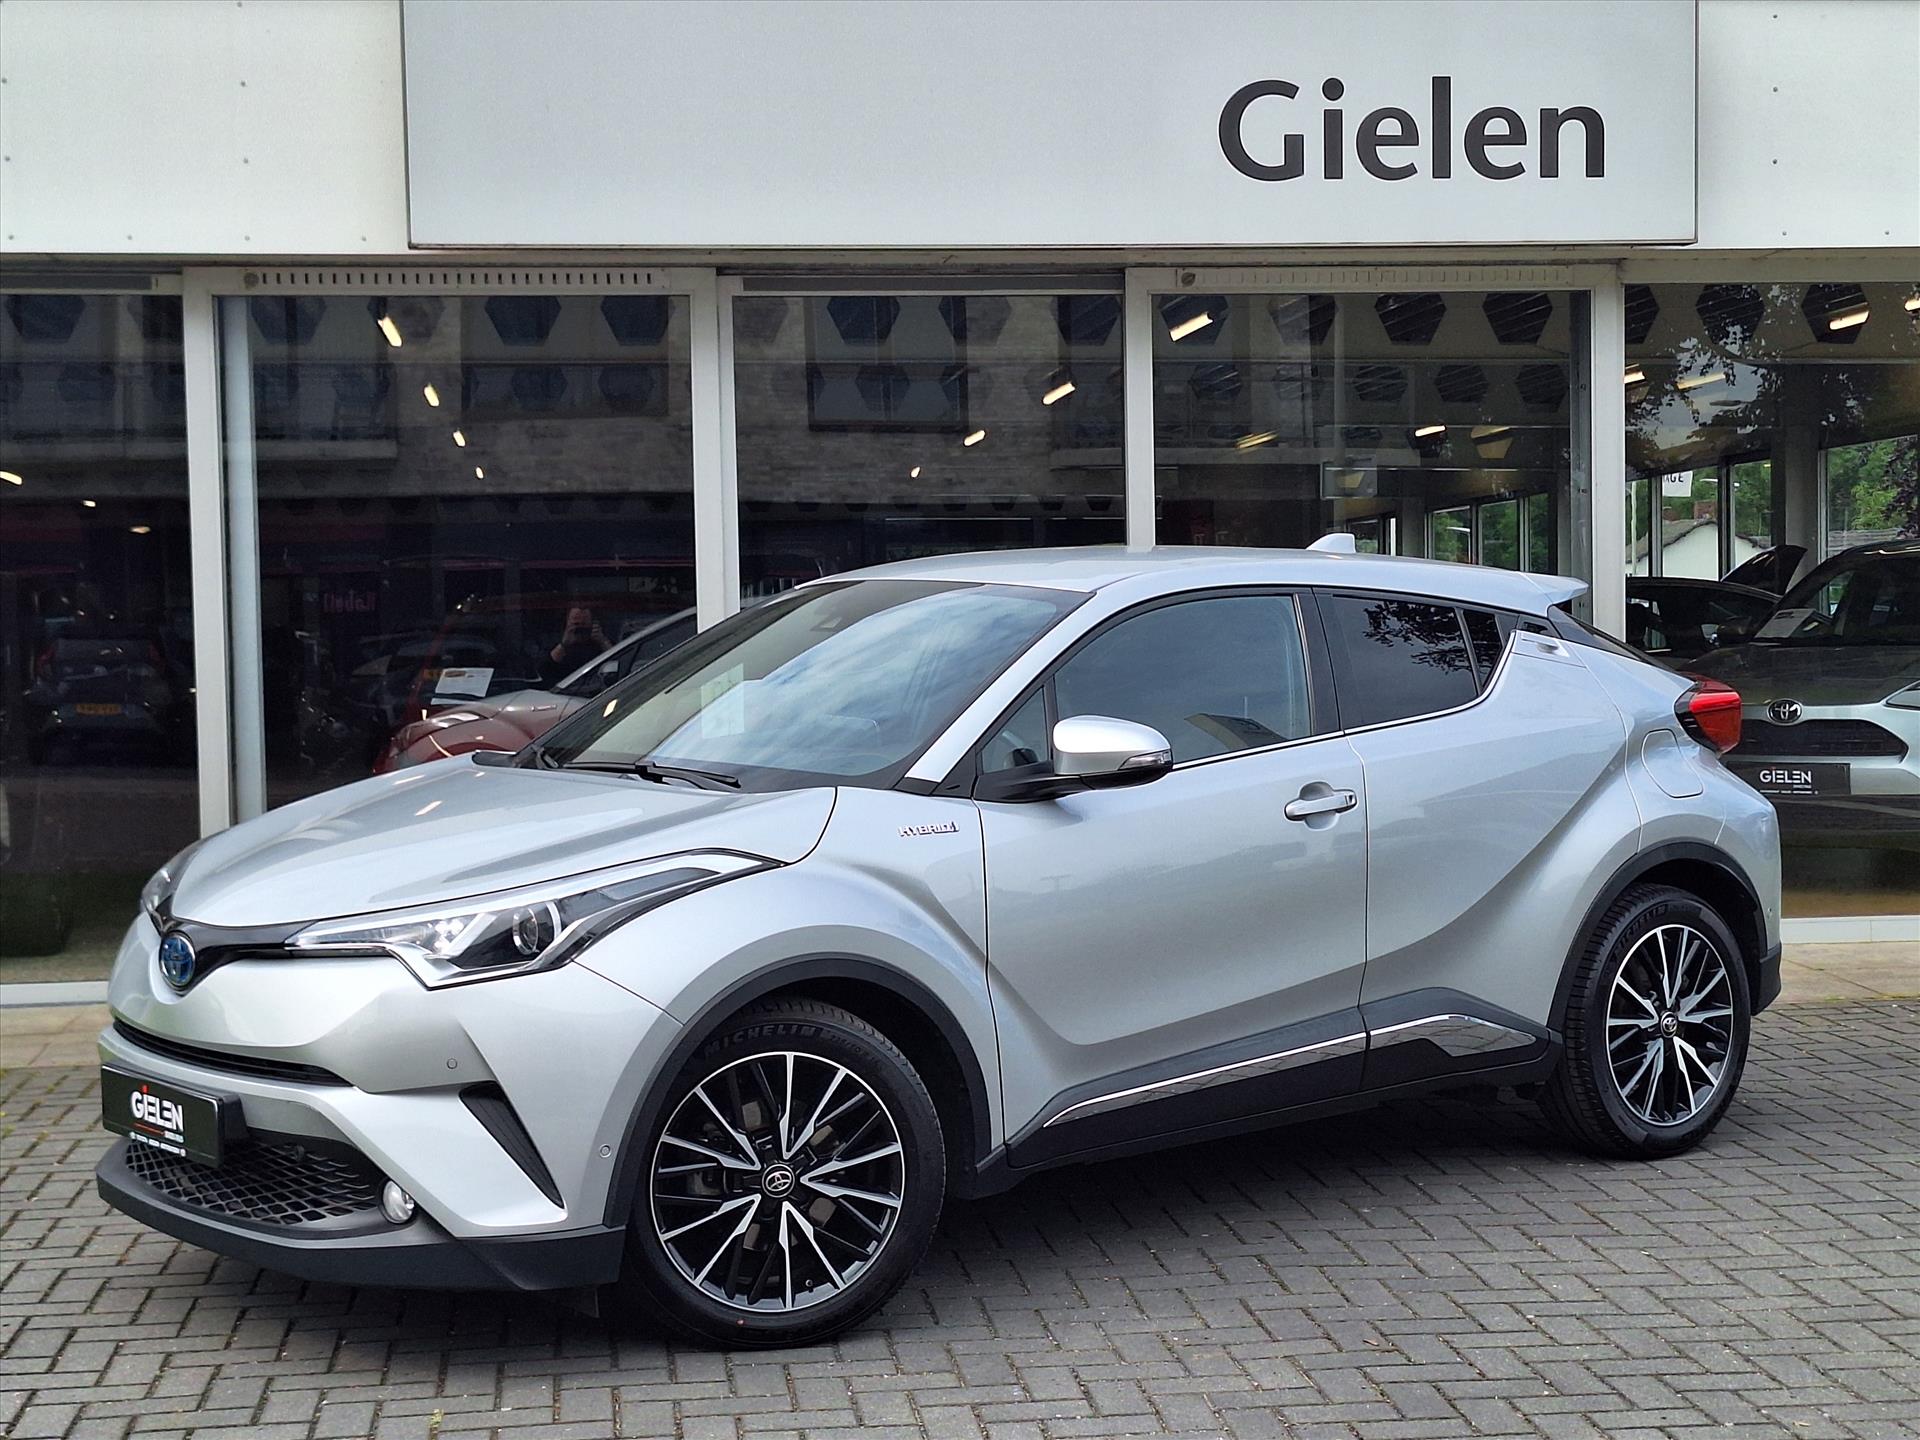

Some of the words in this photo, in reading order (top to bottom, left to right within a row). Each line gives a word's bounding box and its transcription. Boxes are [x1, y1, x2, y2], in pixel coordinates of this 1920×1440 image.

[1219, 76, 1605, 182] Gielen
[1759, 766, 1812, 784] GIELEN
[704, 1023, 818, 1057] MICHELIN
[130, 1084, 185, 1133] GIELEN
